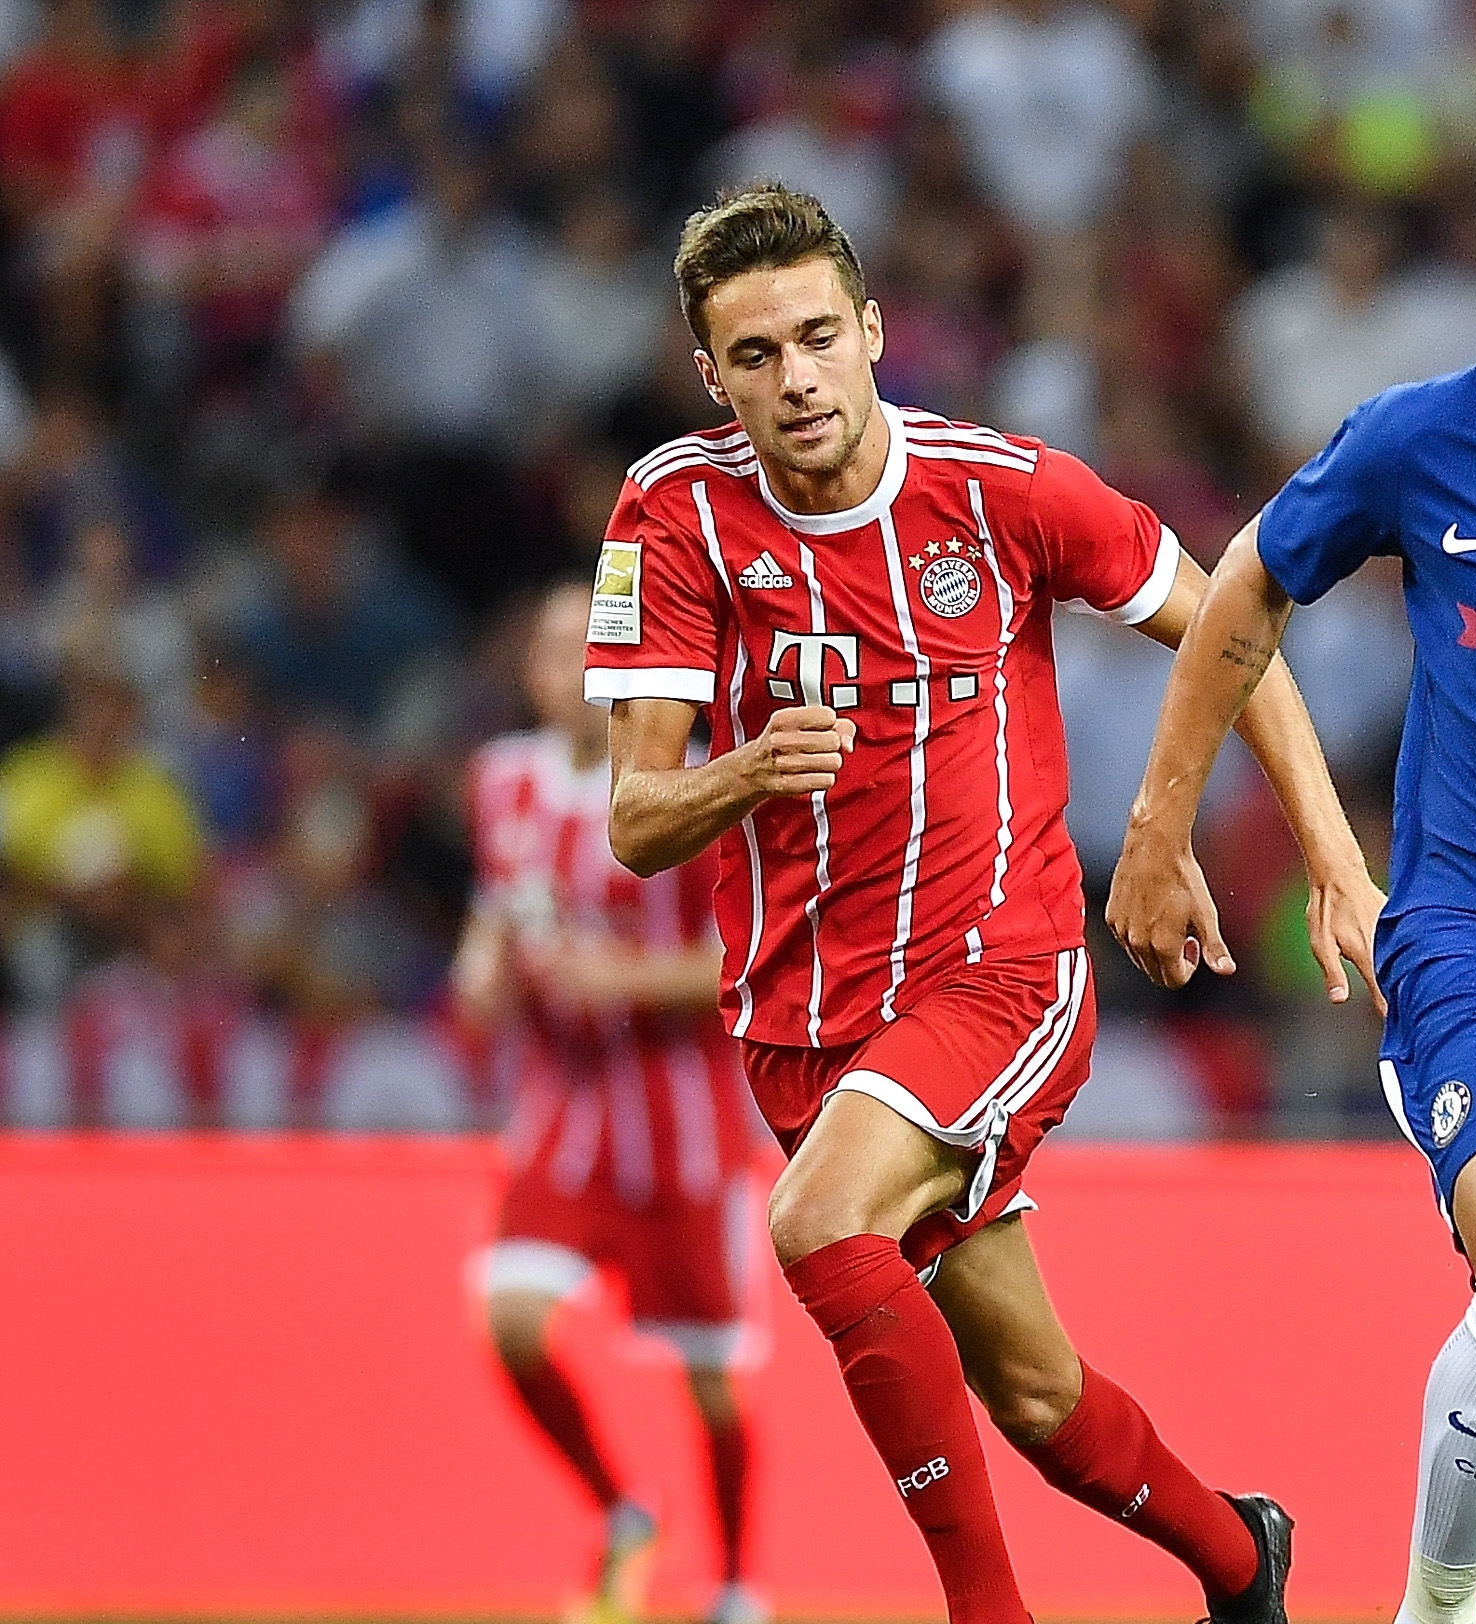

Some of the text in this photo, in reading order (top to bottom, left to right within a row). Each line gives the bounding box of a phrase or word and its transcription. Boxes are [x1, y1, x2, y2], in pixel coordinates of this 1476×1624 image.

[738, 573, 793, 589] adidas
[932, 560, 976, 581] BAYERN
[897, 1456, 949, 1498] FCB
[1121, 1482, 1151, 1518] CB
